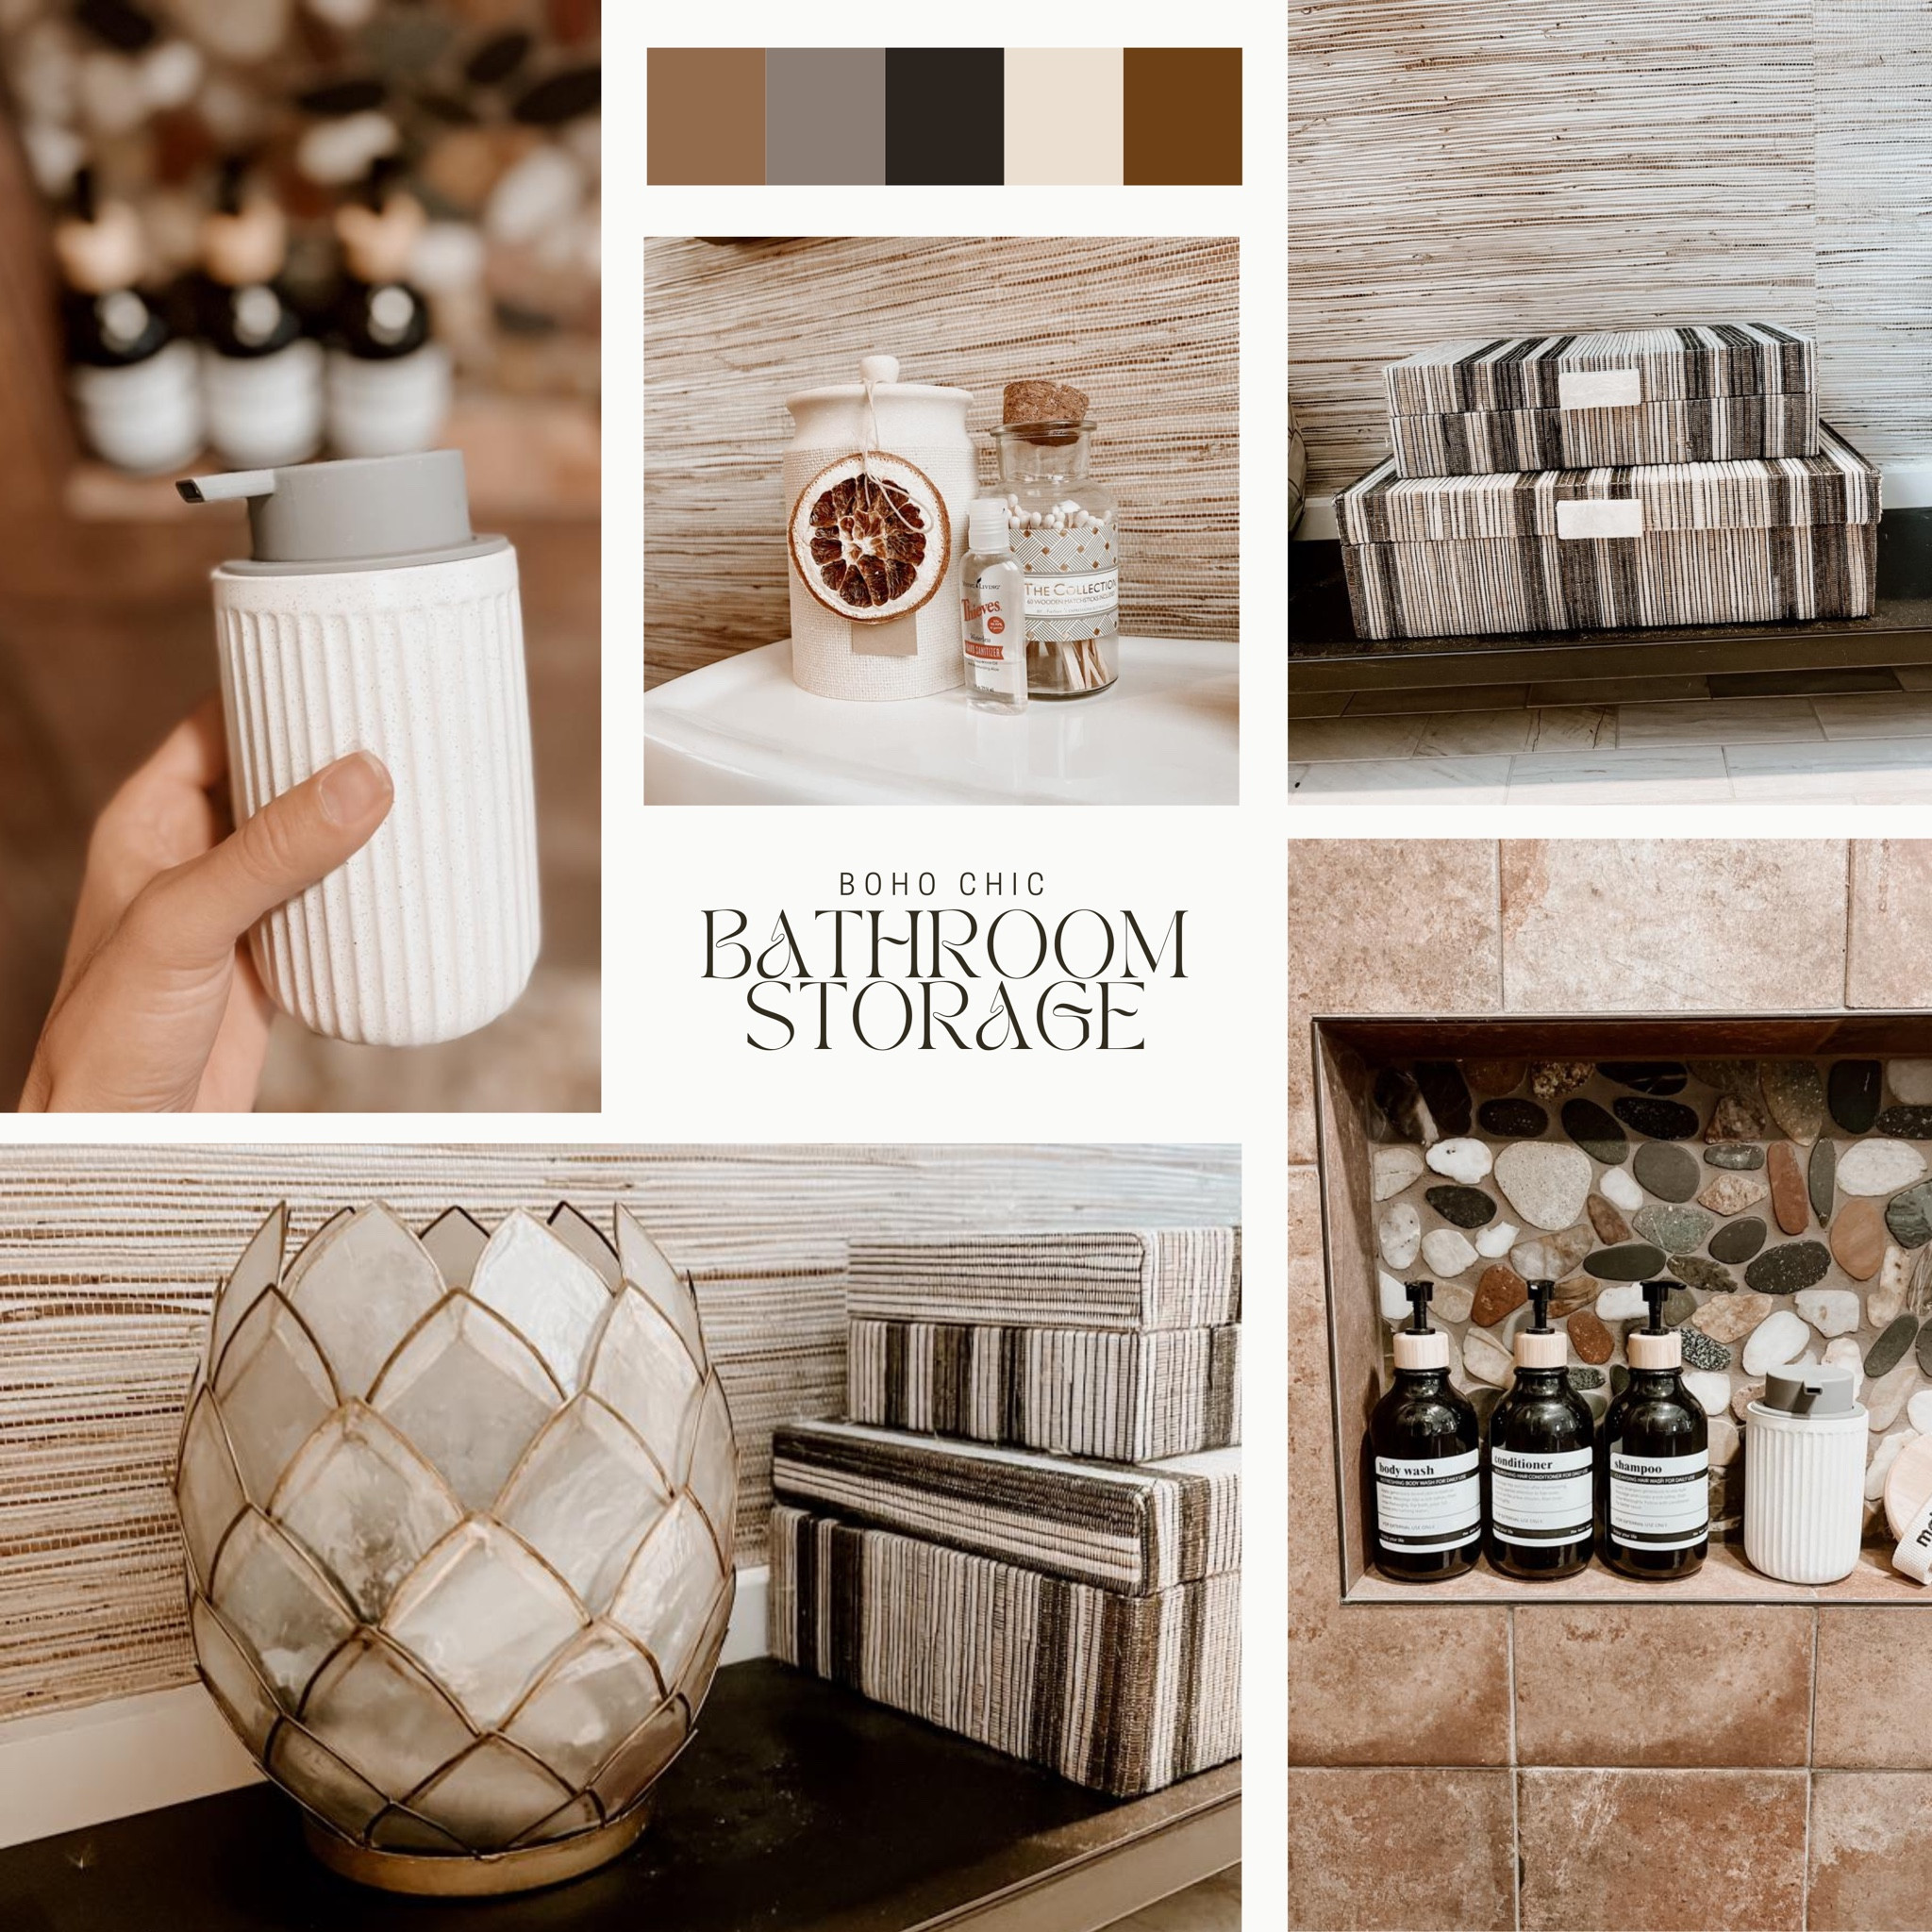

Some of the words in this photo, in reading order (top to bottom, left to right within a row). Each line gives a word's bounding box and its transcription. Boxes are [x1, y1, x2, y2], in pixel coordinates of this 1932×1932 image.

[1024, 583, 1050, 596] THE
[1053, 579, 1117, 596] COLLECTION
[961, 599, 1001, 622] Thieves
[975, 645, 1001, 658] SANITIZER
[1379, 1462, 1402, 1477] body
[1405, 1465, 1434, 1475] wash
[1494, 1456, 1553, 1470] conditioner
[1614, 1459, 1662, 1474] shampoo
